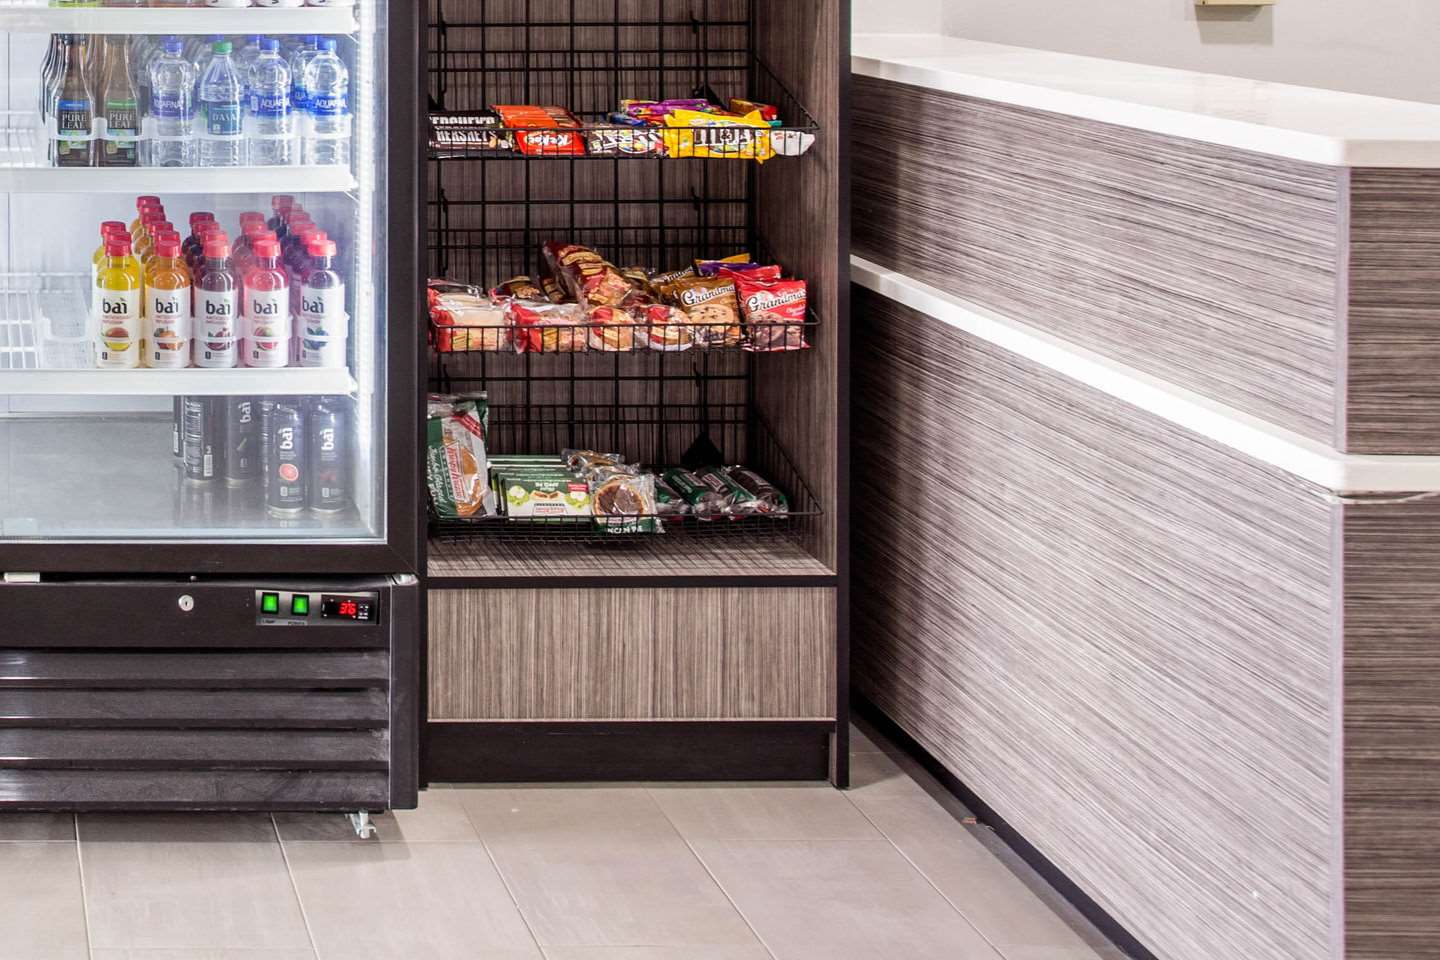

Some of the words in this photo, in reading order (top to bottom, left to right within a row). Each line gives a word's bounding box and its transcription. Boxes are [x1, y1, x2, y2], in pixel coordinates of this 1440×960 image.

[62, 113, 86, 122] PURE
[103, 297, 127, 314] bai
[155, 297, 178, 314] bai
[206, 298, 231, 315] bai
[254, 299, 278, 314] bai
[302, 296, 324, 313] bai
[280, 427, 294, 450] bai
[321, 427, 335, 451] bai
